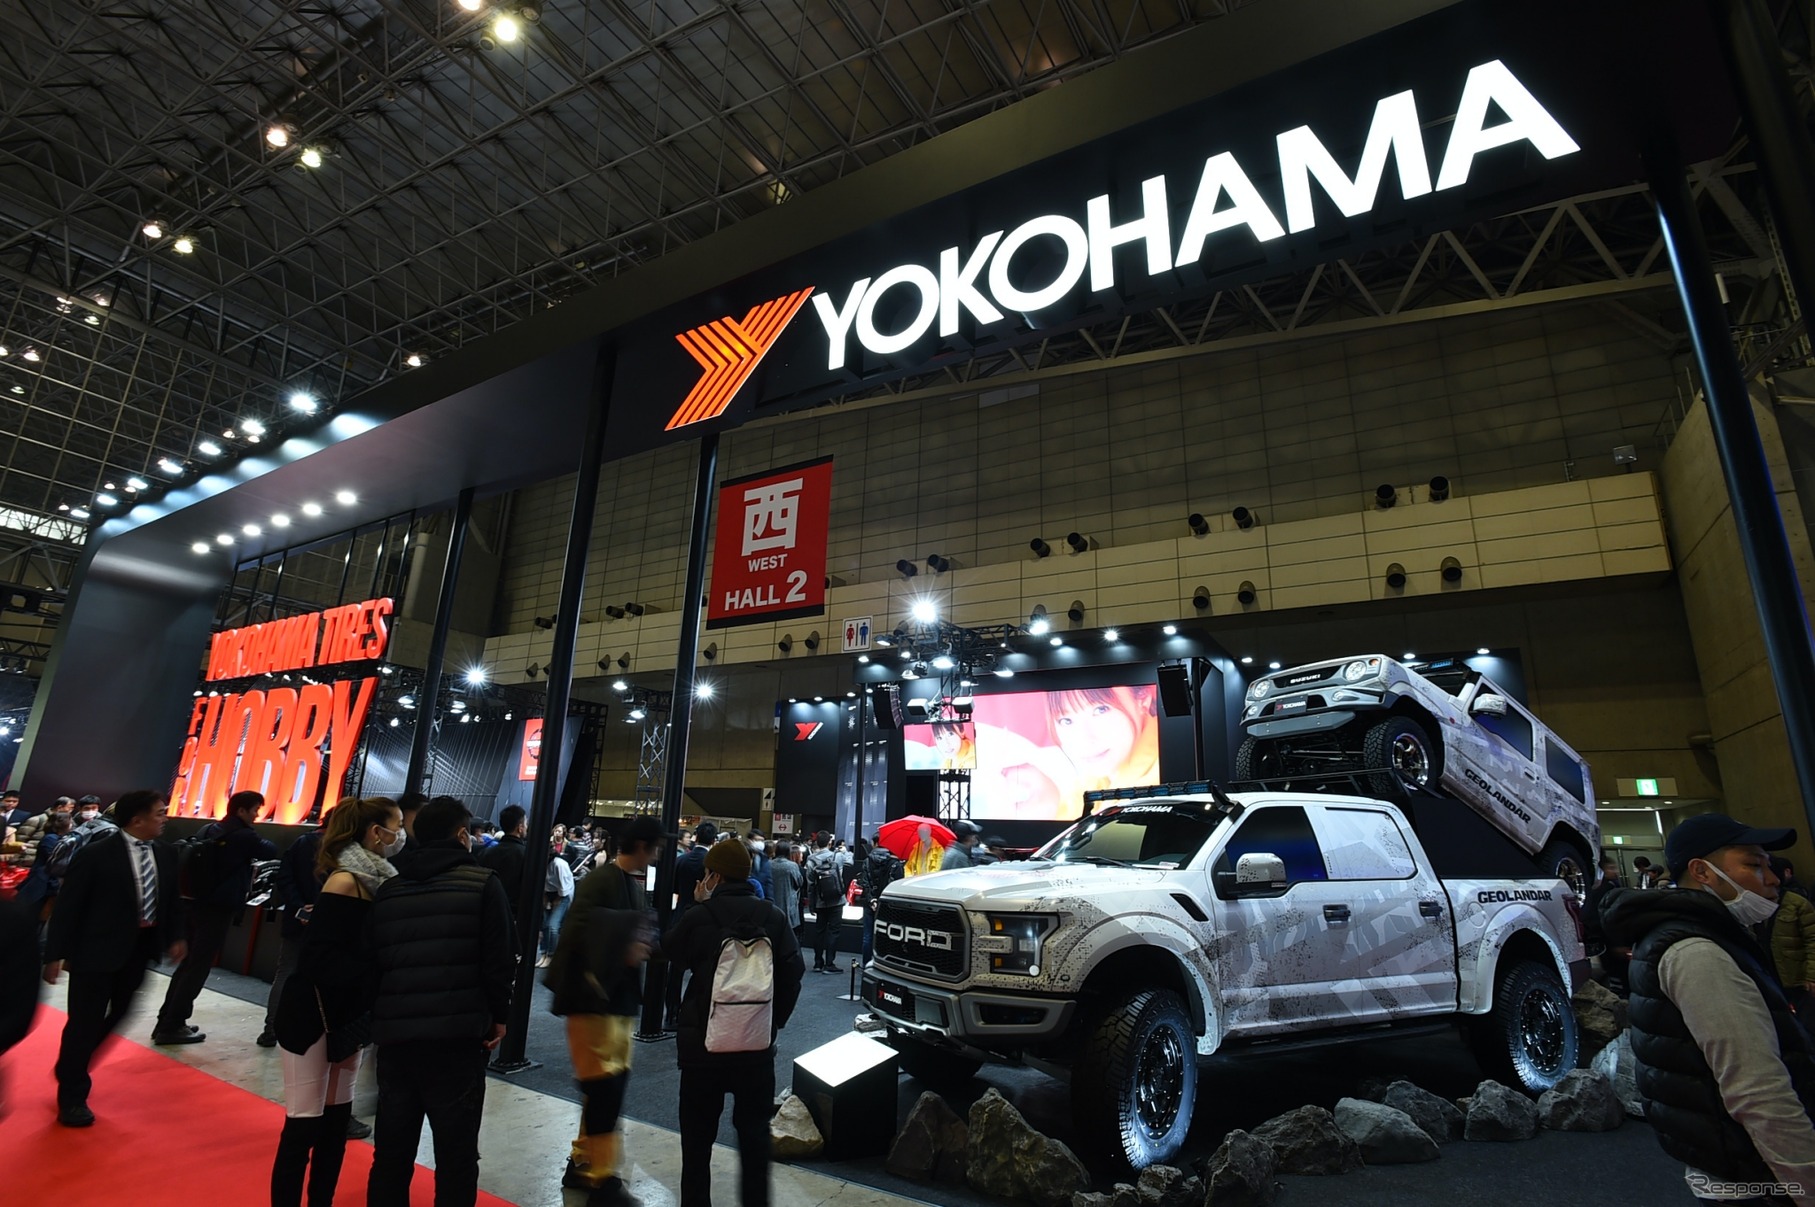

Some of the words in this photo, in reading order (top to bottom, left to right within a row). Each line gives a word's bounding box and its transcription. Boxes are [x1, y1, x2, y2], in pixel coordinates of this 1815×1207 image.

[812, 59, 1581, 371] YOKOHAMA
[741, 477, 803, 556] 西
[748, 553, 788, 572] WEST
[724, 584, 781, 611] HALL
[785, 570, 808, 603] 2
[205, 612, 321, 682] YOKOHAMA
[317, 597, 393, 665] TIRES
[1290, 674, 1321, 684] SUZUKI
[179, 677, 379, 825] HOBBY
[1120, 805, 1174, 814] YOKOHAMA
[1464, 768, 1532, 824] GEOLANDAR
[1477, 890, 1553, 904] GEOLANDAR
[873, 919, 952, 951] FORD
